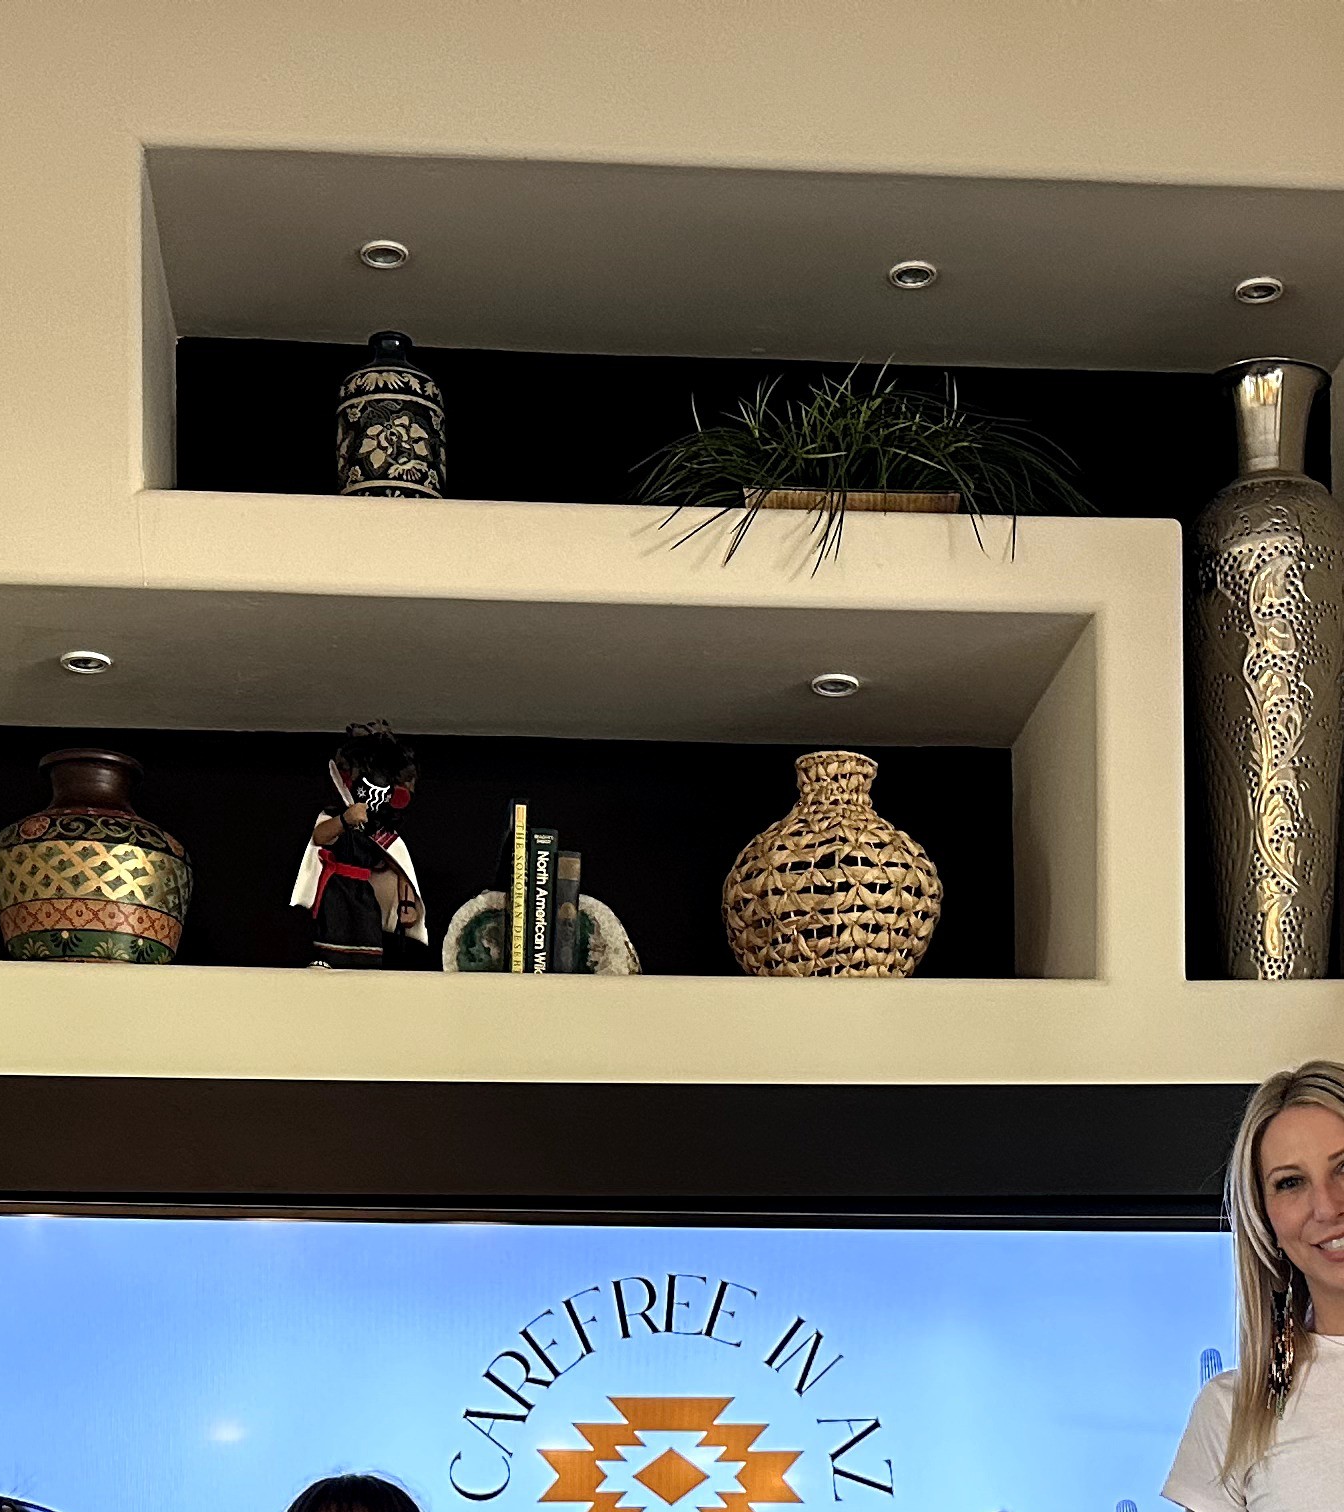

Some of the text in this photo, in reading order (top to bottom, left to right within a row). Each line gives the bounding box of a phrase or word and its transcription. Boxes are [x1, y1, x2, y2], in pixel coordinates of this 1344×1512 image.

[513, 855, 524, 917] SONORAN
[536, 850, 550, 885] North
[534, 887, 549, 950] American
[449, 1274, 895, 1502] CAREFREE IN AZ
